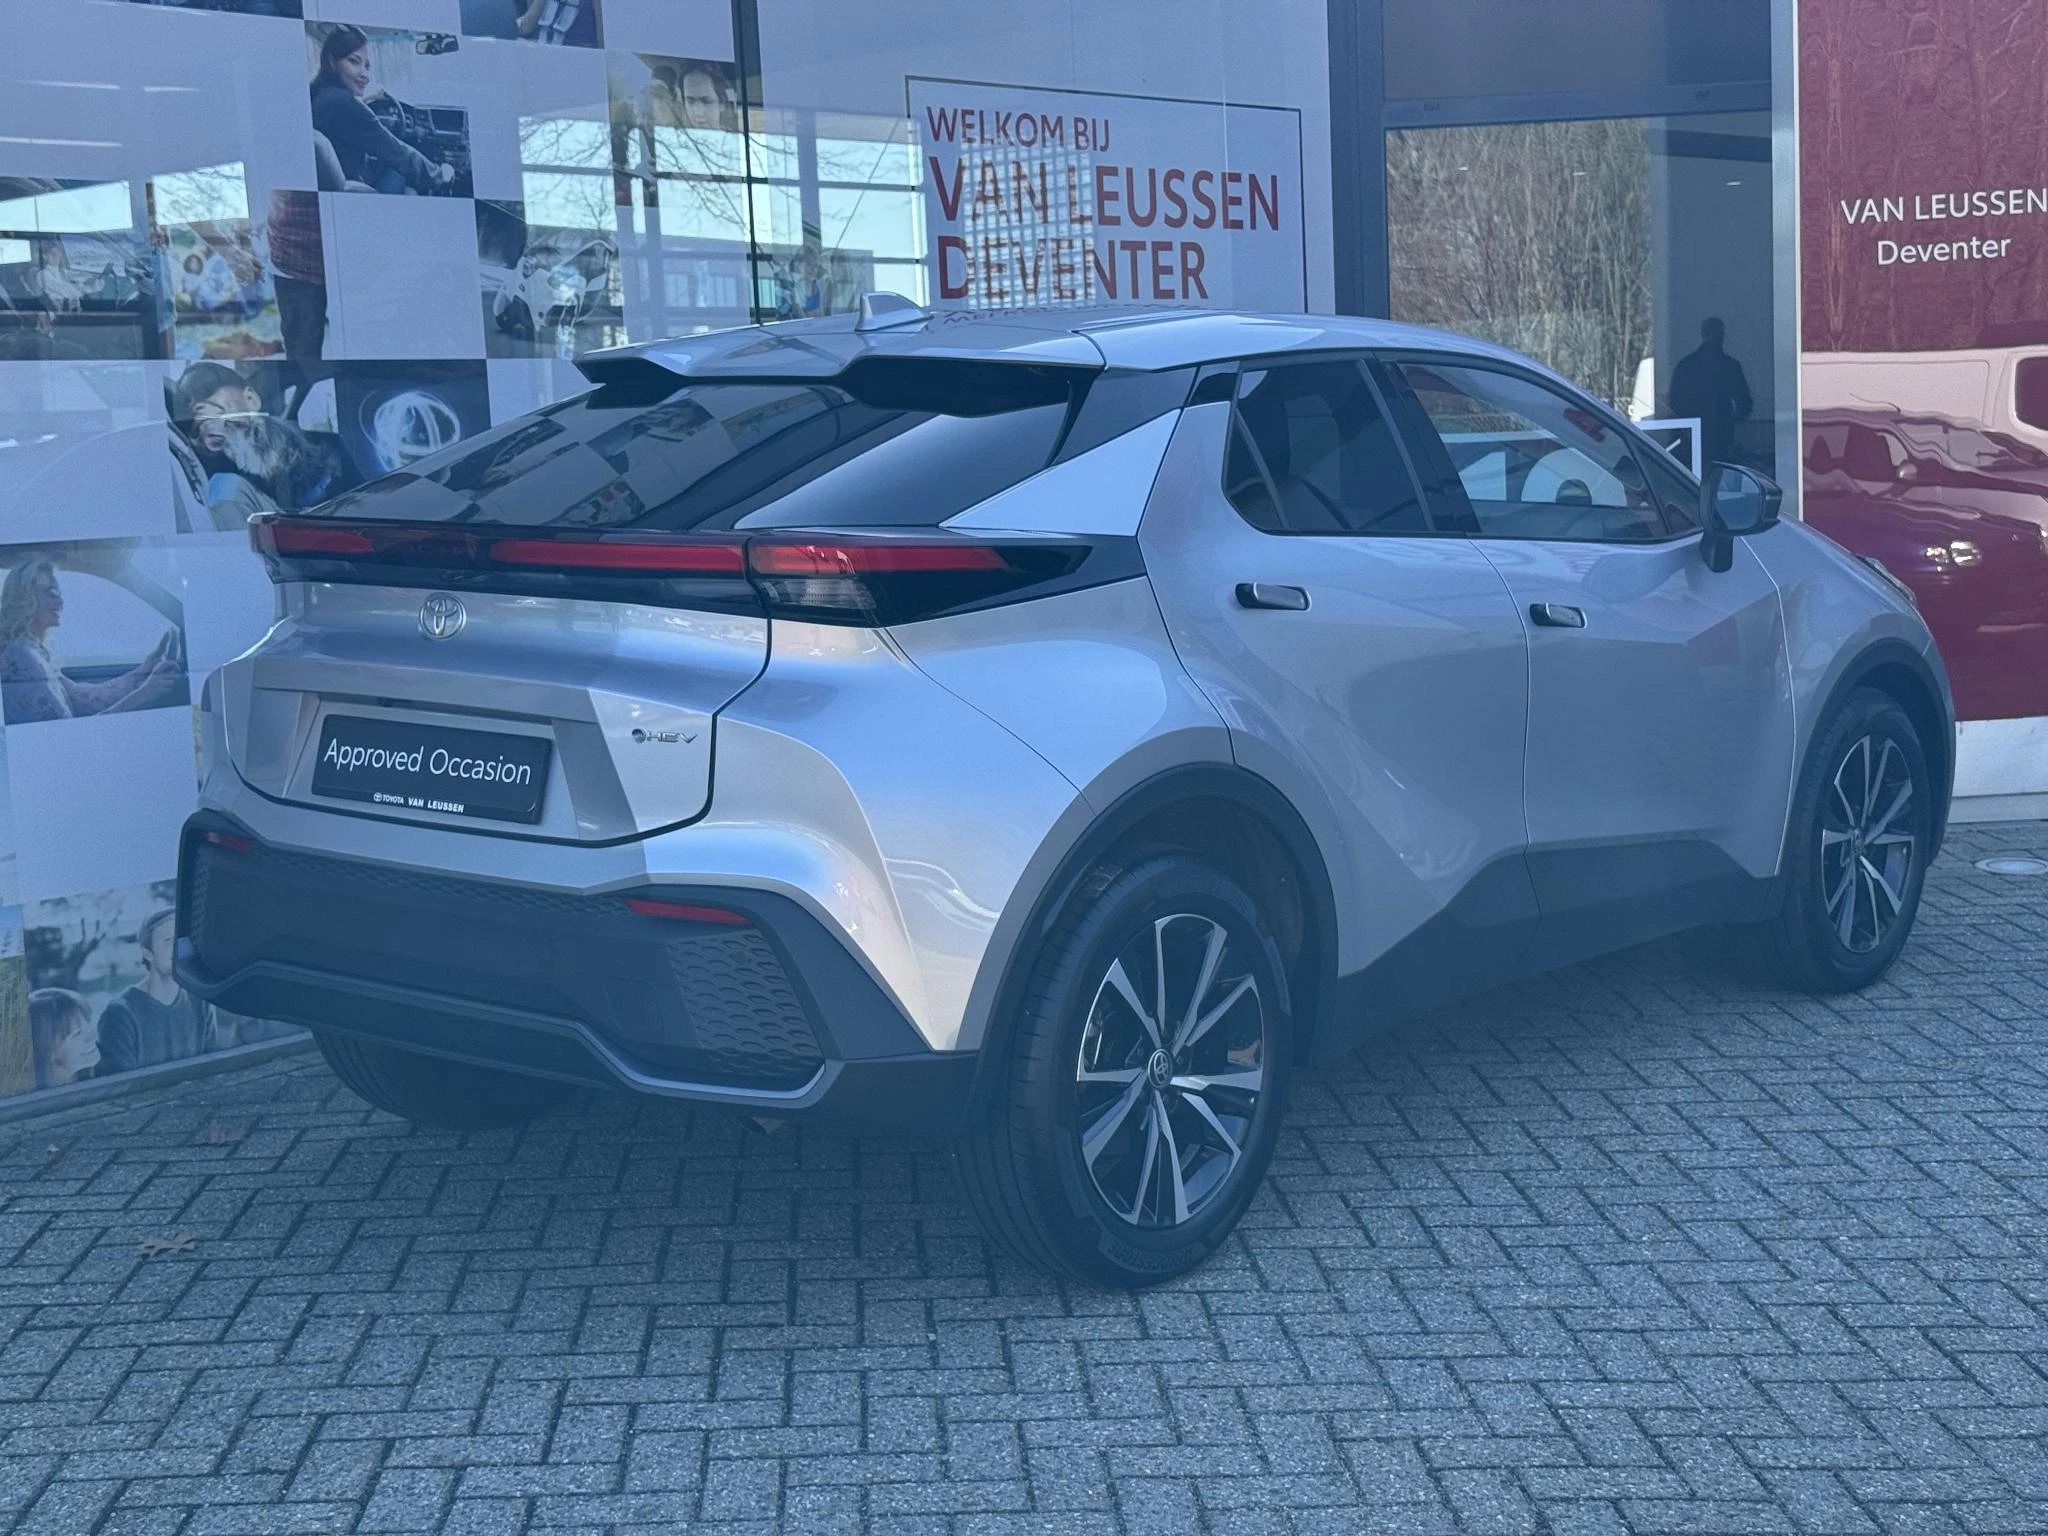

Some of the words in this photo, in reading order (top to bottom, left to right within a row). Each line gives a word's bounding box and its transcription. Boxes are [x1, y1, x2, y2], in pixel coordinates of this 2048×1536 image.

[926, 106, 1065, 149] WELKOM
[1074, 116, 1110, 152] BIJ
[928, 156, 1049, 225] VAN
[1068, 163, 1279, 231] LEUSSEN
[1840, 196, 1904, 225] VAN
[1915, 188, 2048, 220] LEUSSEN
[937, 236, 1209, 300] DEVENTER
[1877, 236, 2011, 265] Deventer
[646, 731, 698, 744] HEV
[323, 738, 424, 772] Approved
[429, 749, 532, 785] Occasion
[382, 794, 404, 804] TOYOTA
[408, 797, 424, 808] VAN
[427, 800, 465, 813] LEUSSEN
